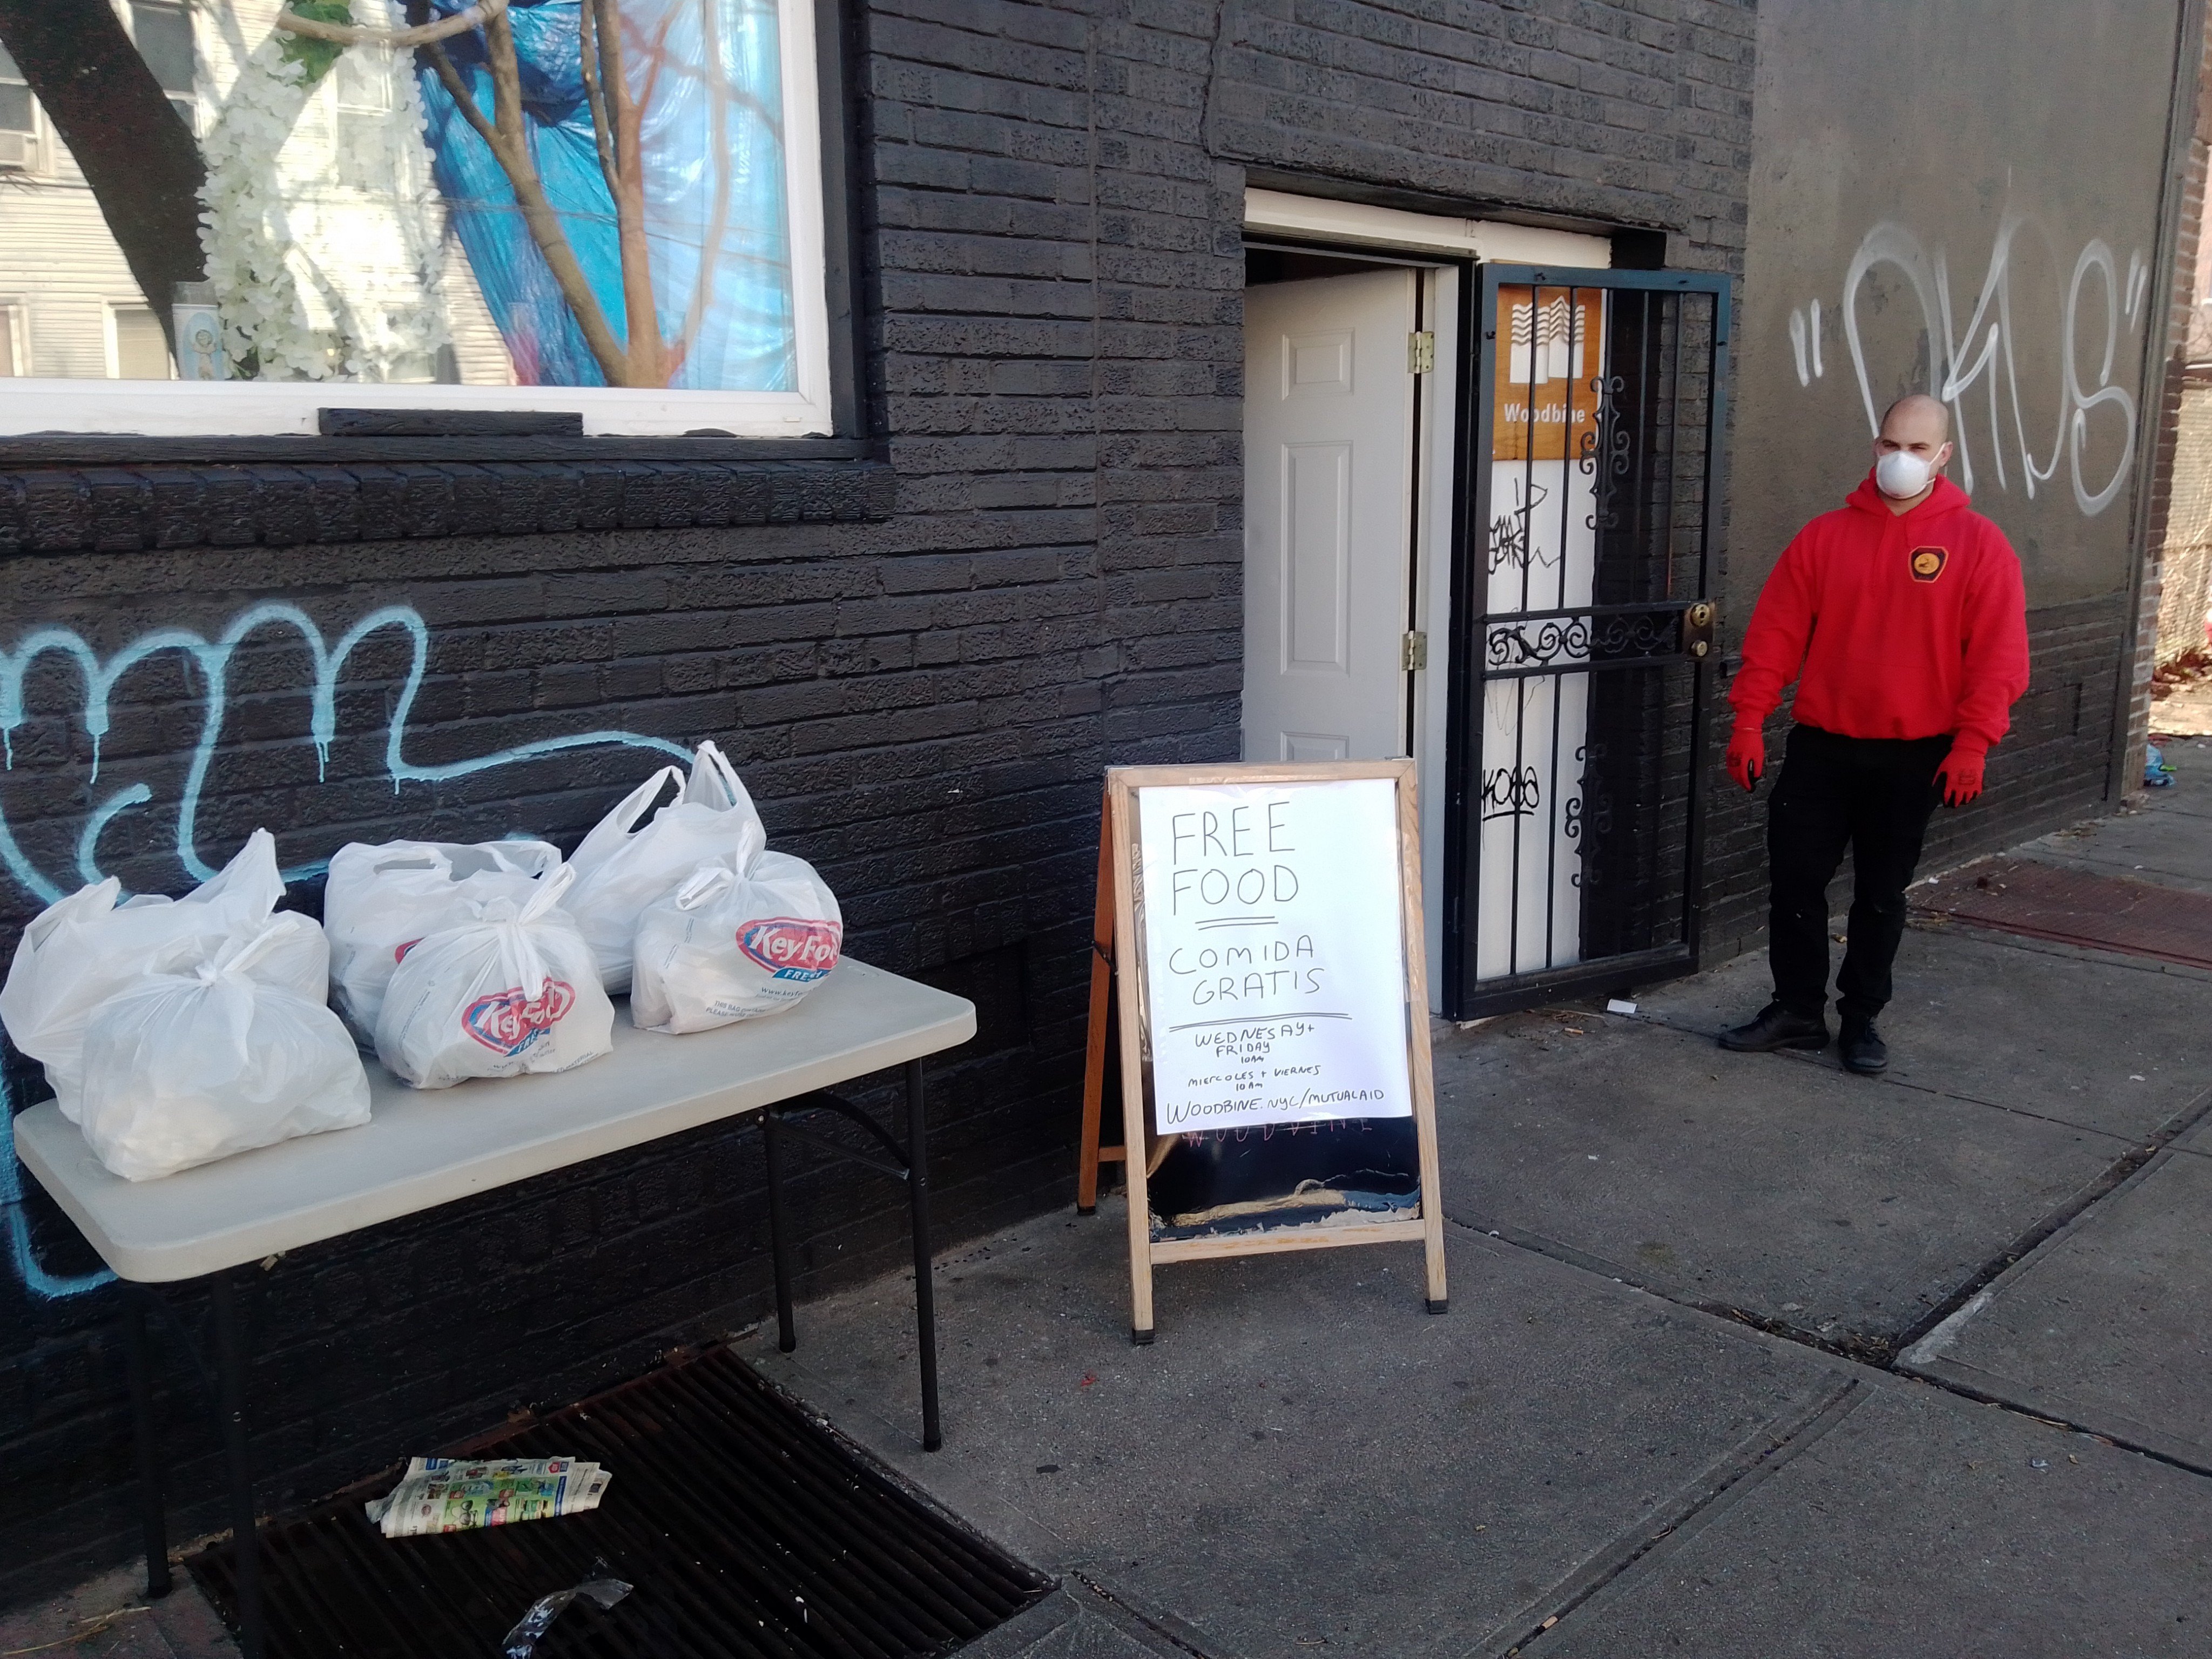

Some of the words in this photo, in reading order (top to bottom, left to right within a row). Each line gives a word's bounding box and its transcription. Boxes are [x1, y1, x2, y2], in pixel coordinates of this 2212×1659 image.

[1172, 801, 1296, 865] FREE
[1173, 865, 1299, 916] FOOD
[1169, 934, 1314, 975] COMIDA
[1192, 968, 1325, 1005] GRATIS
[714, 1000, 727, 1009] THIS
[727, 1003, 741, 1013] BAG
[1215, 1041, 1270, 1058] FRIDAY
[1274, 1064, 1321, 1077] VIERNES
